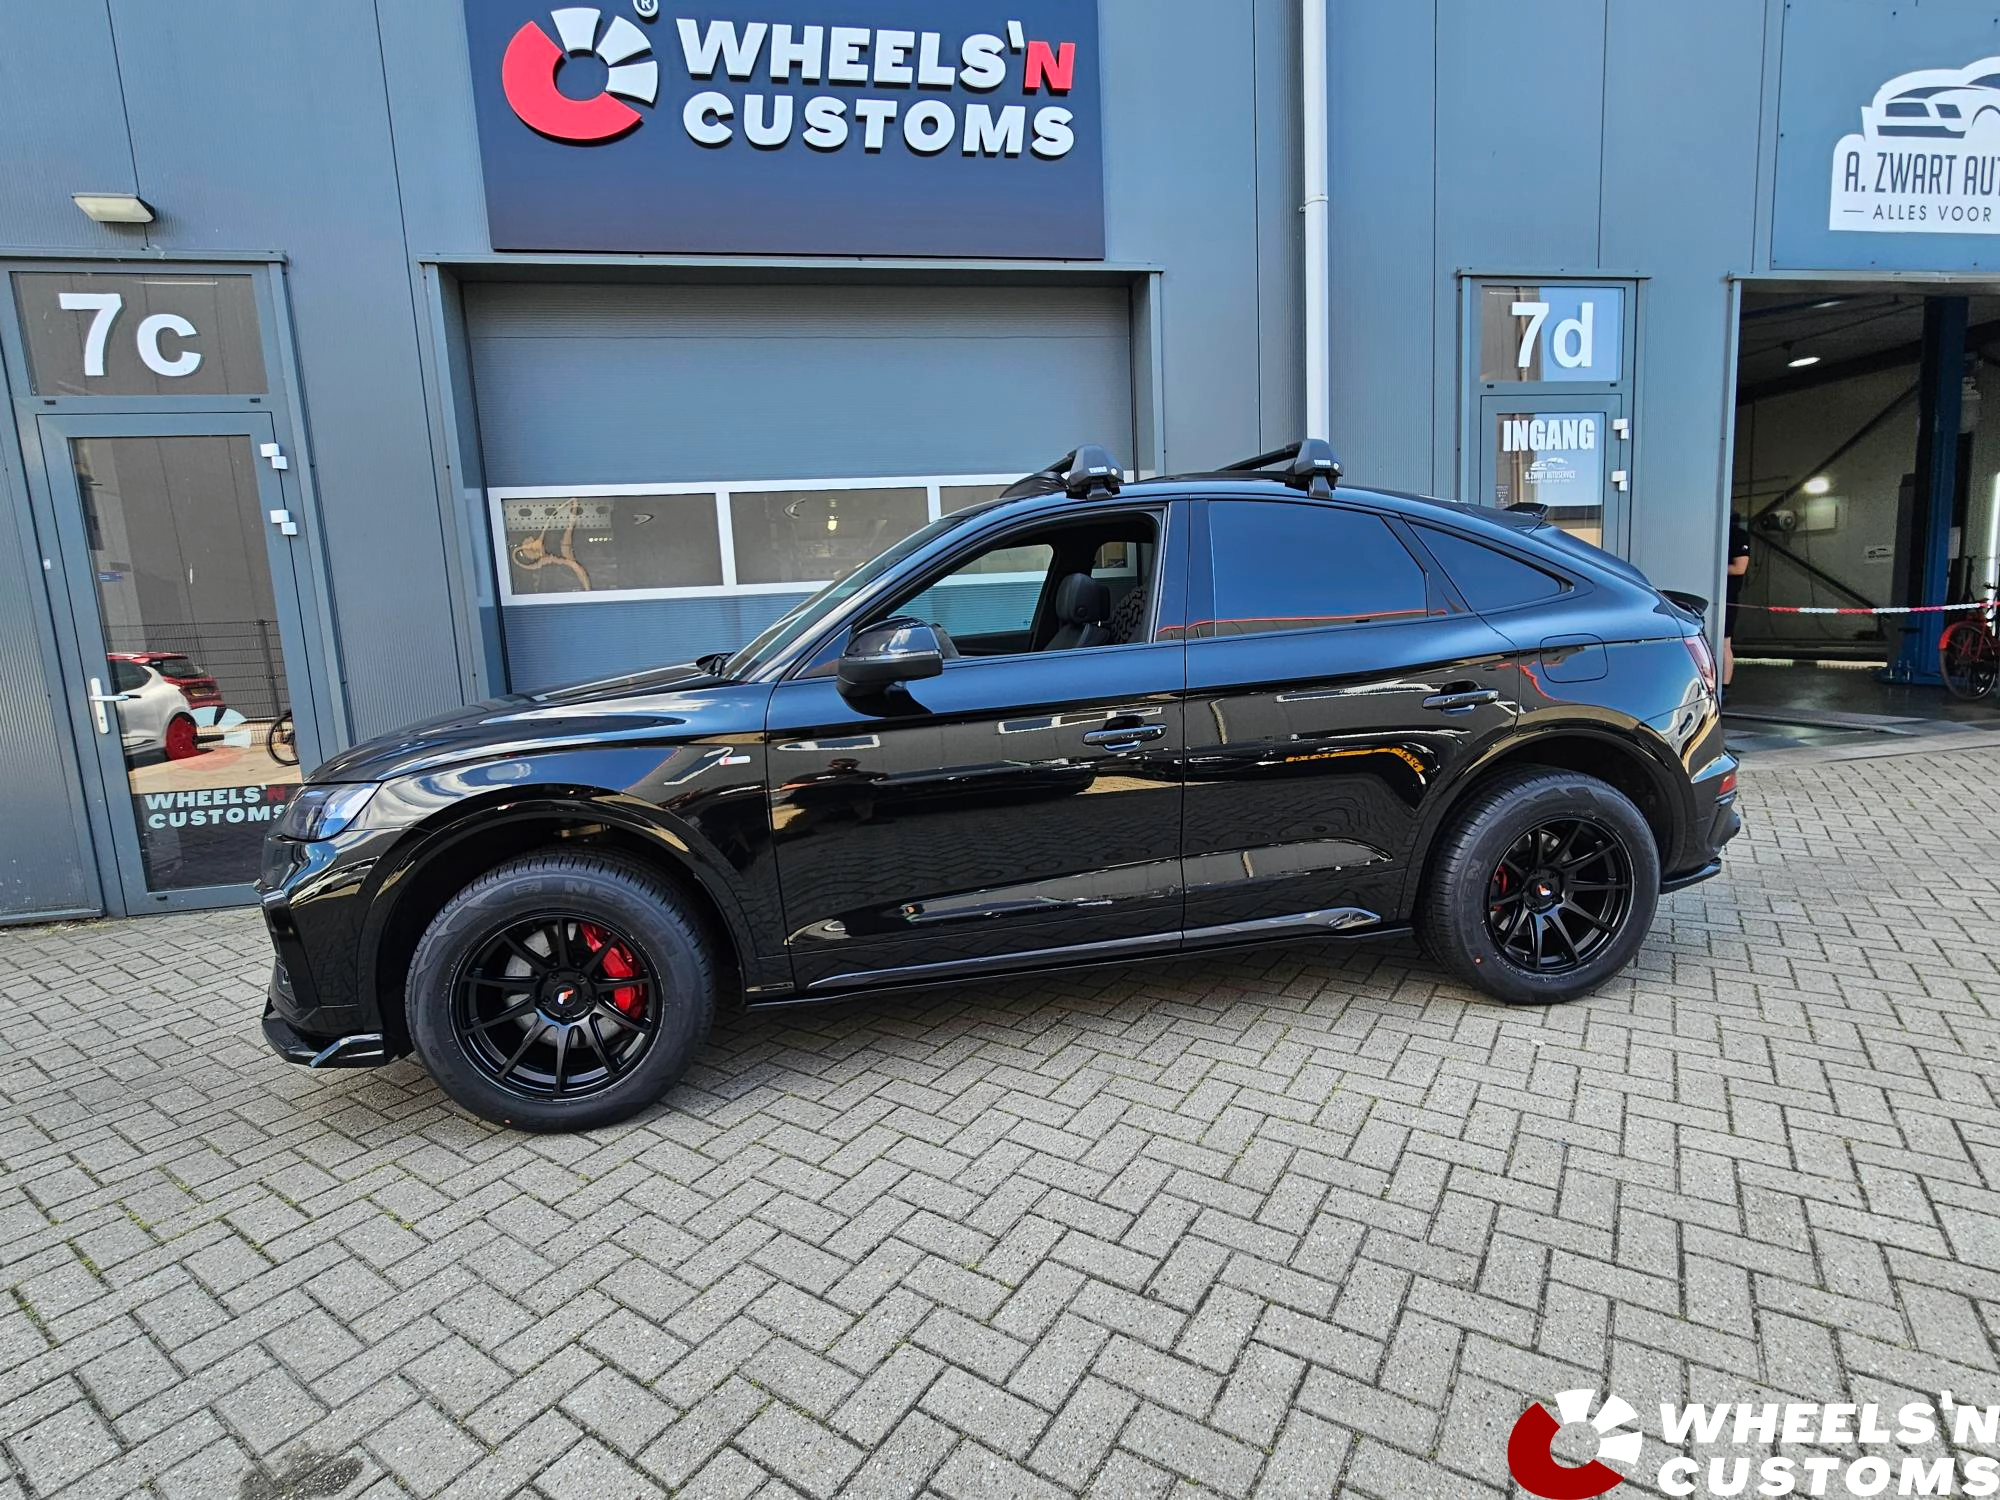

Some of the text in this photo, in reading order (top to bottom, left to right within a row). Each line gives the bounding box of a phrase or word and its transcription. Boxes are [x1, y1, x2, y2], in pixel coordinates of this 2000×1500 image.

[682, 91, 1075, 156] CUSTOMS
[1844, 151, 1866, 192] A.
[1874, 152, 1957, 195] ZWART
[1873, 204, 1992, 222] ALLES VOOR
[1511, 302, 1594, 368] 7d
[1502, 419, 1595, 451] INGANG
